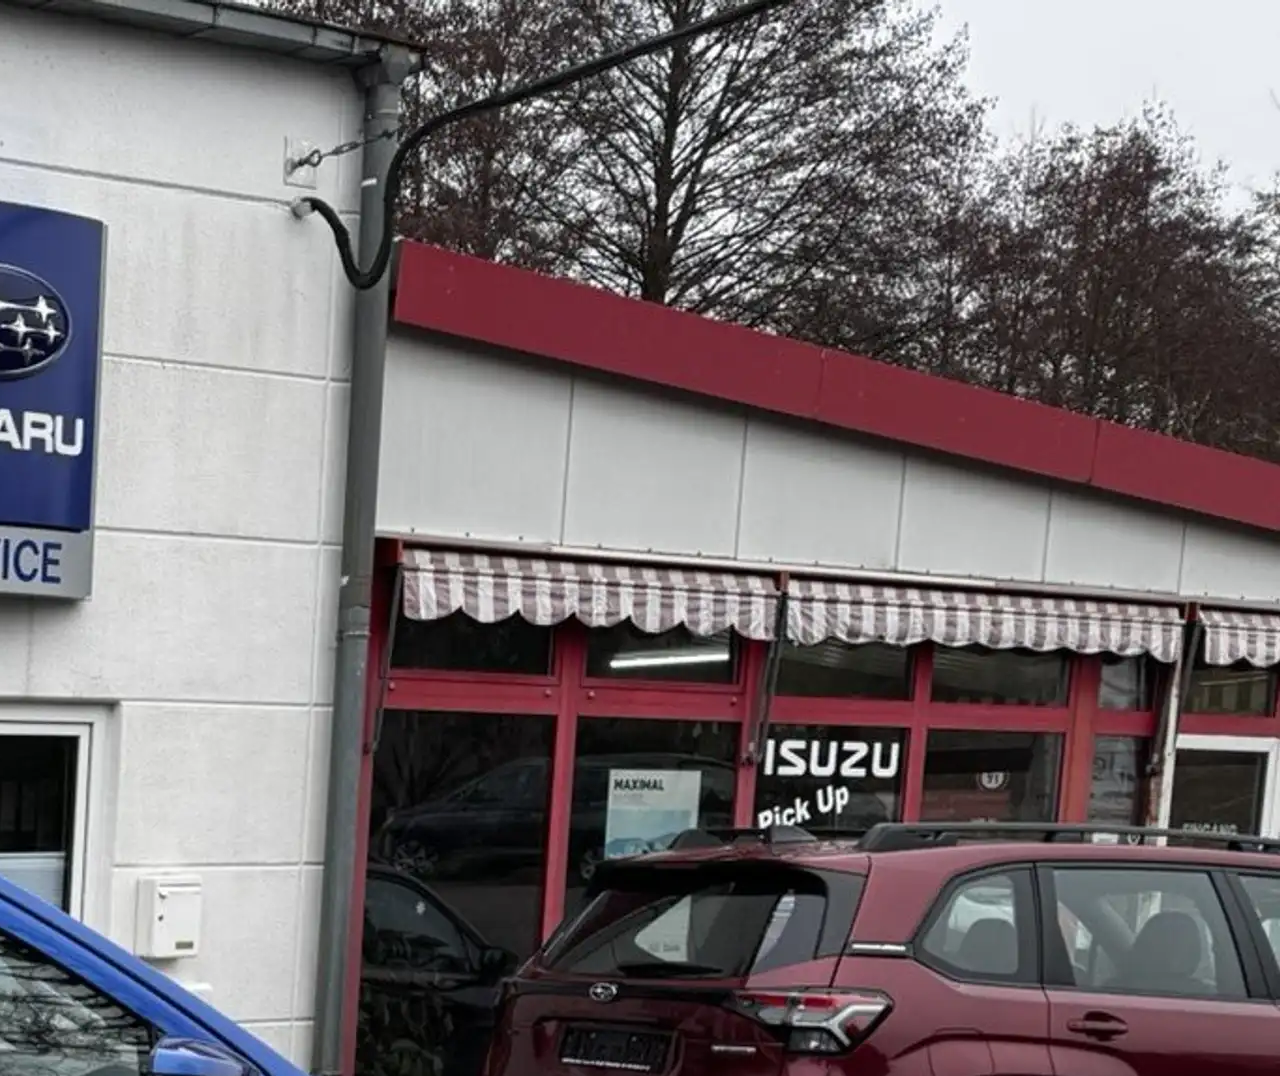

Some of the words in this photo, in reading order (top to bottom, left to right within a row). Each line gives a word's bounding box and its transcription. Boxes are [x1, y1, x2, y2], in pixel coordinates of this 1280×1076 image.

[764, 738, 900, 778] ISUZU
[613, 779, 664, 791] MAXIMAL
[758, 797, 811, 829] Pick
[816, 785, 850, 814] Up
